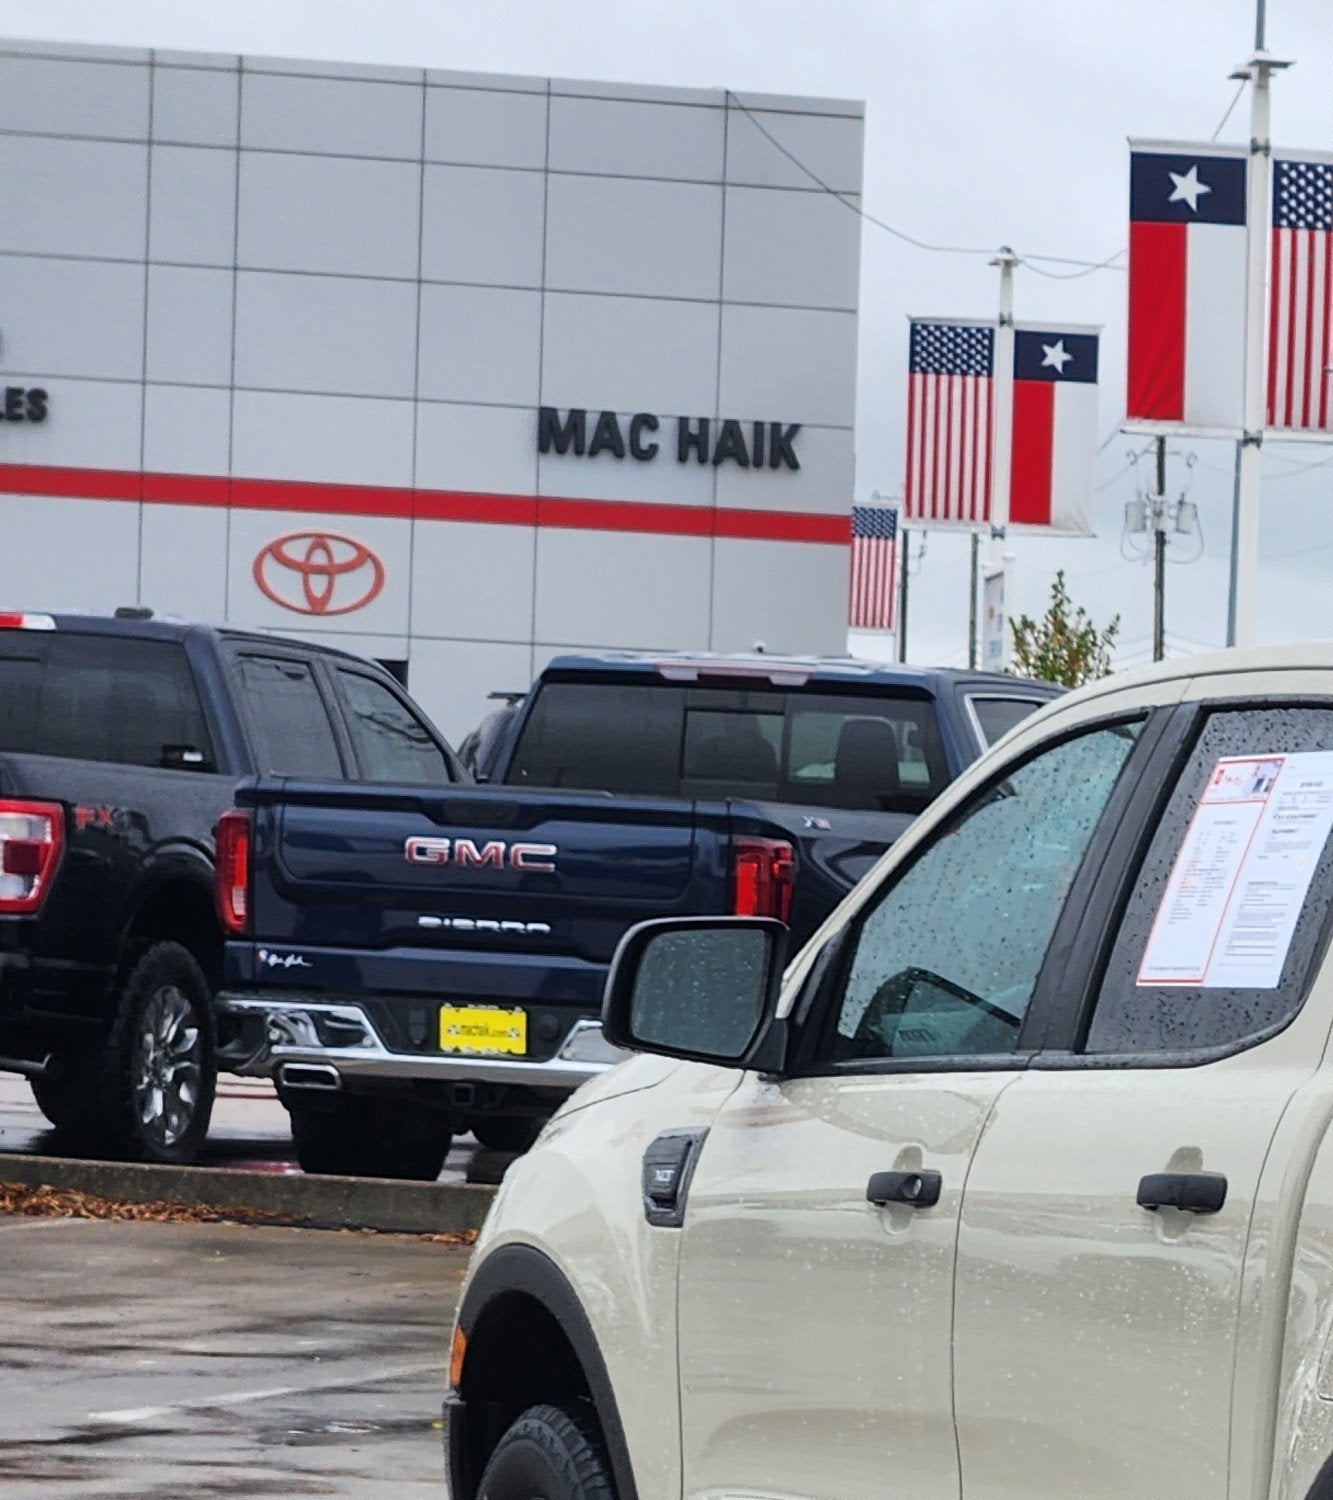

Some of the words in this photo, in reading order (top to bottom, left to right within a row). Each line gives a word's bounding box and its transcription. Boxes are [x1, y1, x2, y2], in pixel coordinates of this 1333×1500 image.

[0, 386, 49, 423] ES
[538, 406, 659, 461] MAC
[677, 416, 801, 470] HAIK
[405, 835, 557, 873] GMC
